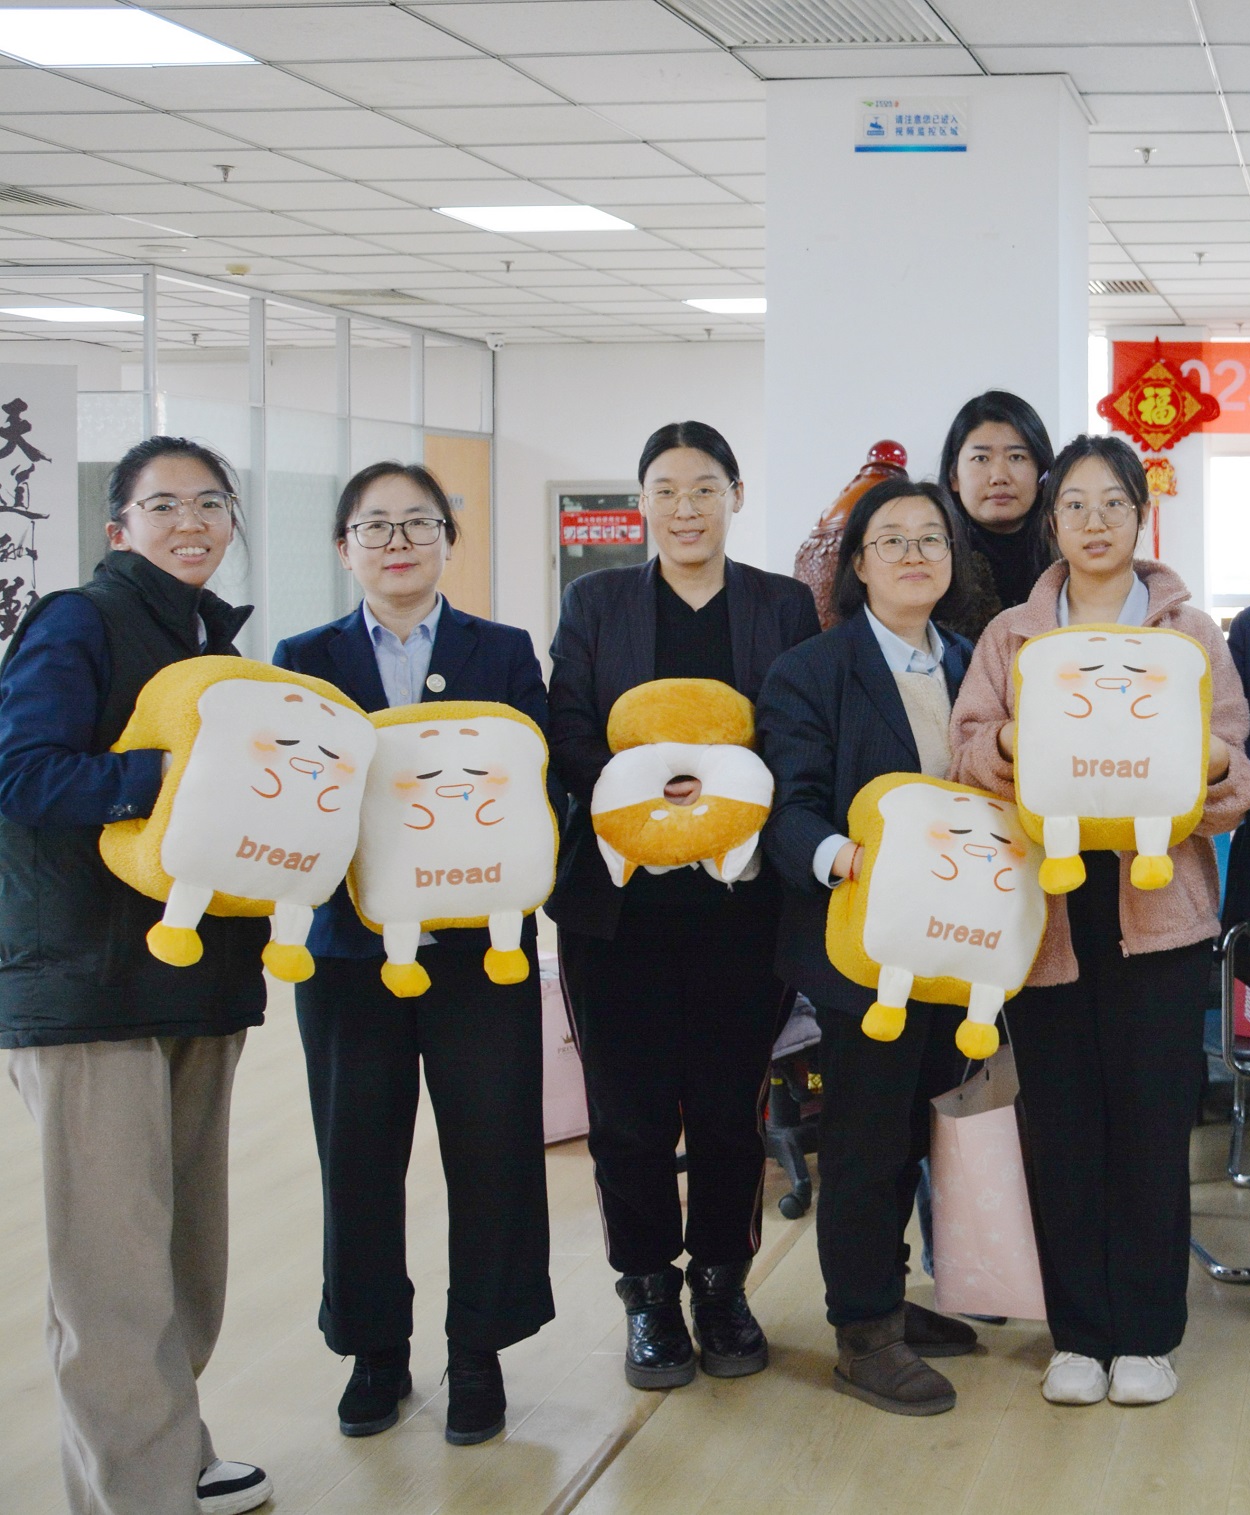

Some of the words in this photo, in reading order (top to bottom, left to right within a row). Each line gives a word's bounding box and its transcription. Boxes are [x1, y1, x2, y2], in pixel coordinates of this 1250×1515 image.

[895, 114, 958, 125] 请注意您已进入
[895, 126, 959, 136] 视频监控区域
[1137, 386, 1177, 426] 福
[1071, 755, 1151, 779] bread
[235, 835, 321, 873] bread
[415, 862, 502, 888] bread
[925, 915, 1003, 950] bread
